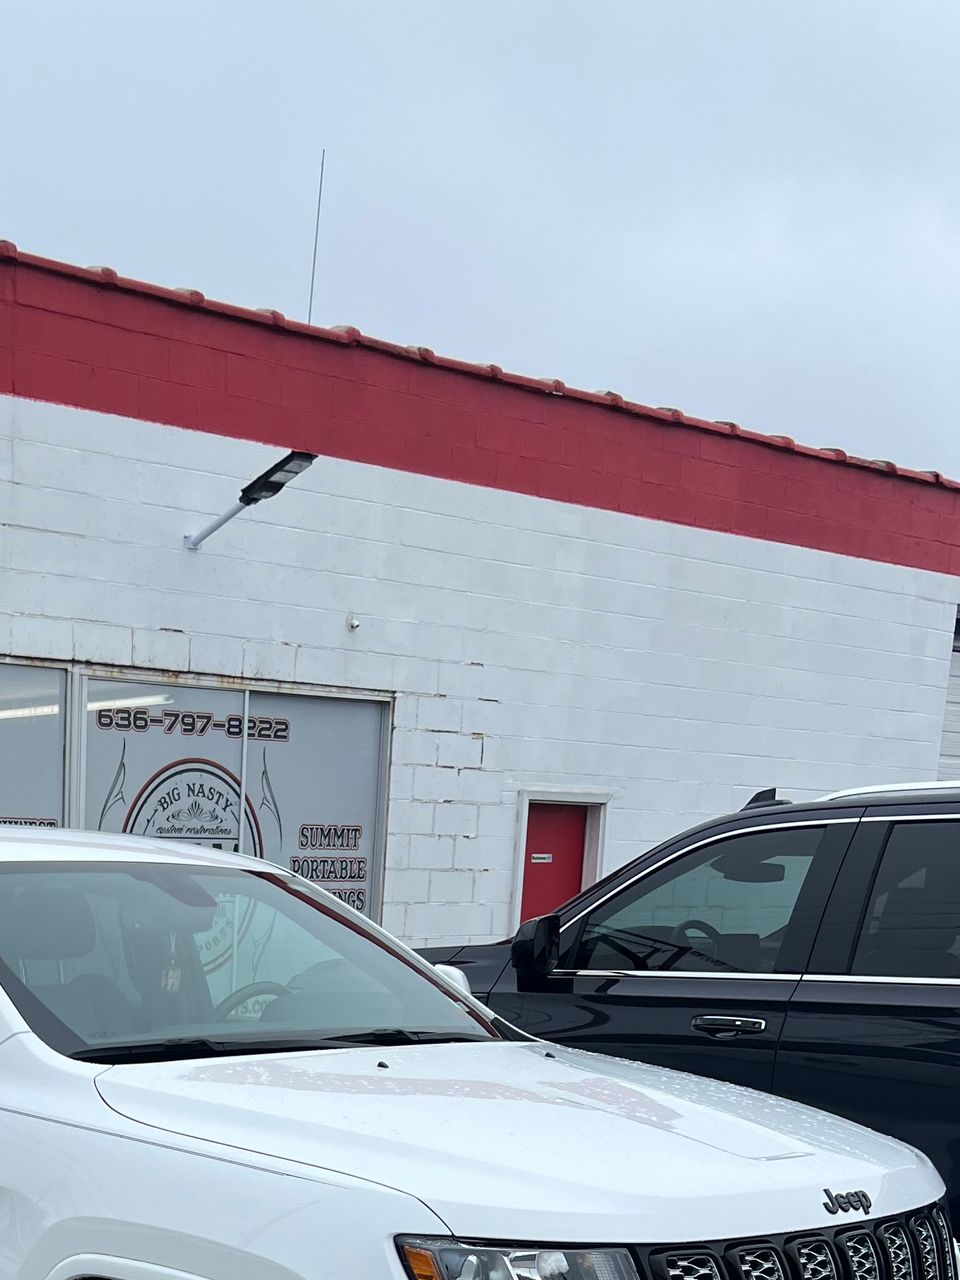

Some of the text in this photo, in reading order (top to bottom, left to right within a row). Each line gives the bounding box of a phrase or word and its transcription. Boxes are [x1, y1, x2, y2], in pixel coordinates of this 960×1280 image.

[97, 708, 289, 741] 636-797-8222
[158, 782, 234, 813] BIG NASTY
[299, 825, 361, 849] SUMMIT
[291, 857, 366, 881] PORTABLE
[822, 1188, 872, 1215] Jeep
